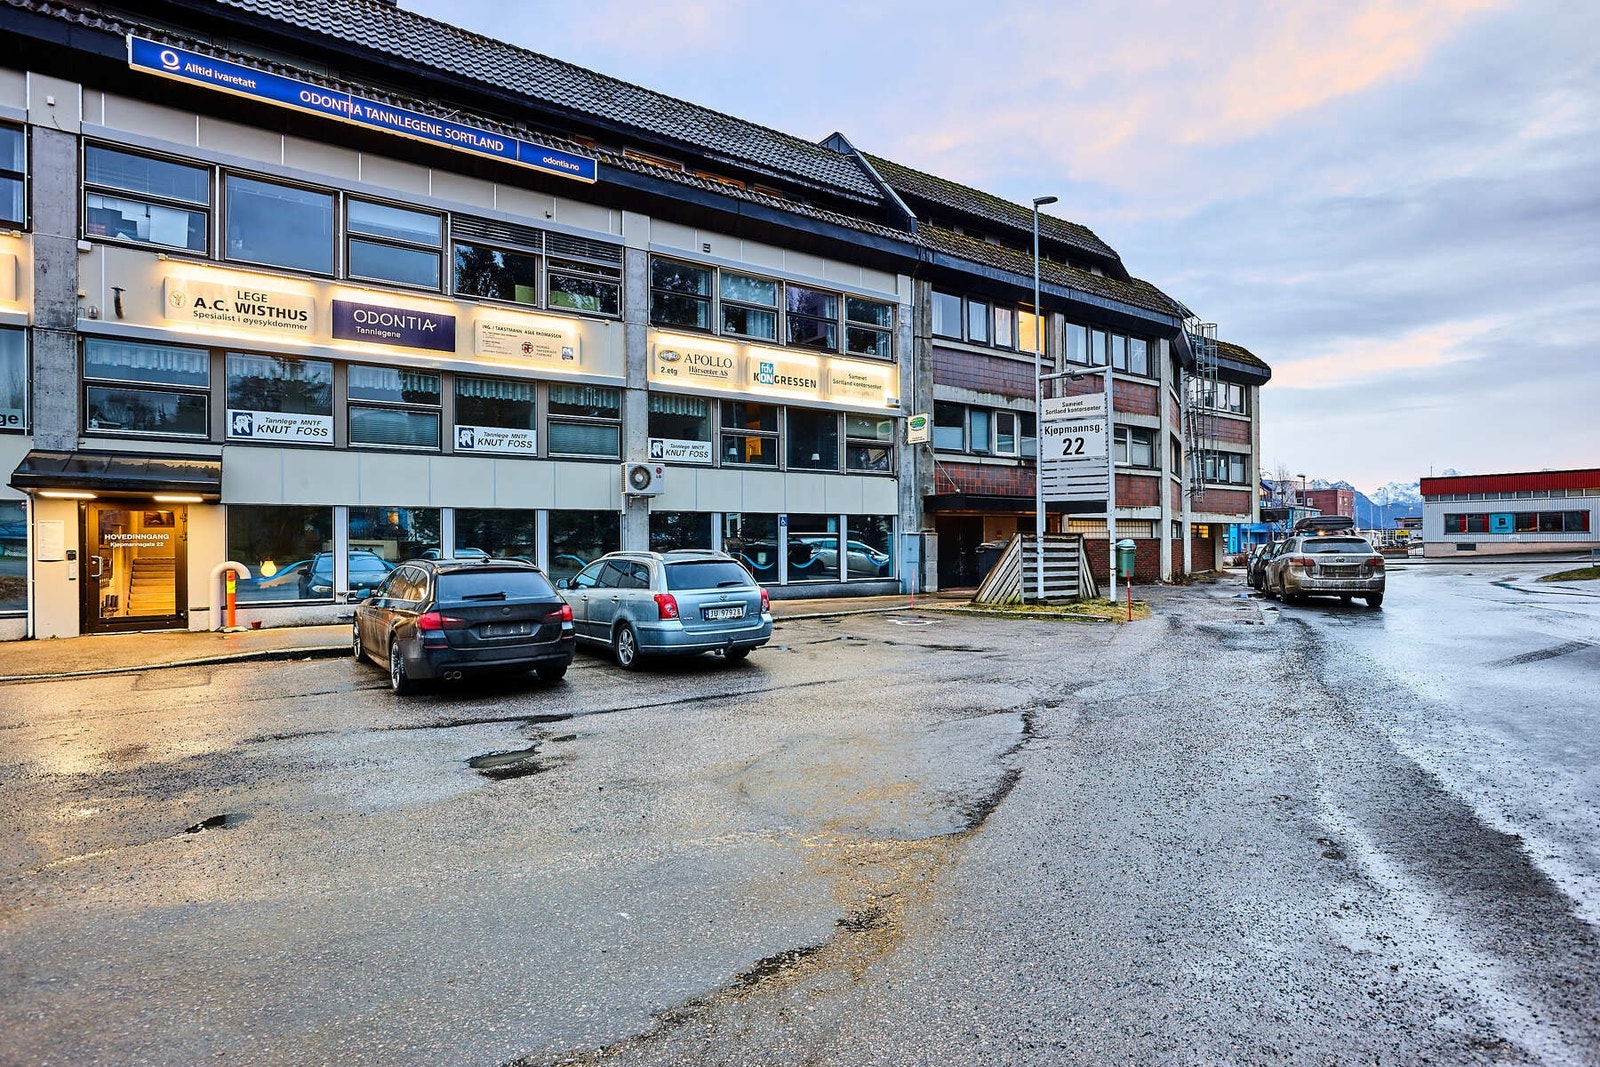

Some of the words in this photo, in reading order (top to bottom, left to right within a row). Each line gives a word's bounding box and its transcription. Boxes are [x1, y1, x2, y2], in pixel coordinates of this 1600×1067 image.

[184, 62, 212, 78] Alltid
[214, 69, 256, 89] ivaretatt
[300, 90, 362, 117] ODONTIA
[364, 106, 443, 137] TANNLEGENE
[444, 128, 504, 152] SORTLAND
[542, 155, 580, 172] odontia.no
[237, 290, 268, 303] LEGE
[193, 297, 229, 312] A.C.
[235, 302, 308, 322] WISTHUS
[193, 310, 236, 322] Spesialist
[243, 316, 308, 331] øyesykdommer
[353, 309, 437, 332] ODONTIA
[355, 326, 401, 338] Tannlegene
[684, 353, 733, 369] APOLLO
[719, 369, 729, 377] AS
[760, 363, 773, 374] fdv
[753, 371, 817, 389] KONGRESSEN
[265, 416, 297, 425] Tannlege
[257, 424, 291, 434] KNUT
[296, 426, 329, 437] FOSS
[1044, 424, 1103, 436] Kjøpmannsg.
[477, 438, 504, 447] KNUT
[507, 440, 533, 449] FOSS
[1062, 437, 1085, 456] 22
[665, 449, 686, 457] KNUT
[688, 450, 709, 459] FOSS
